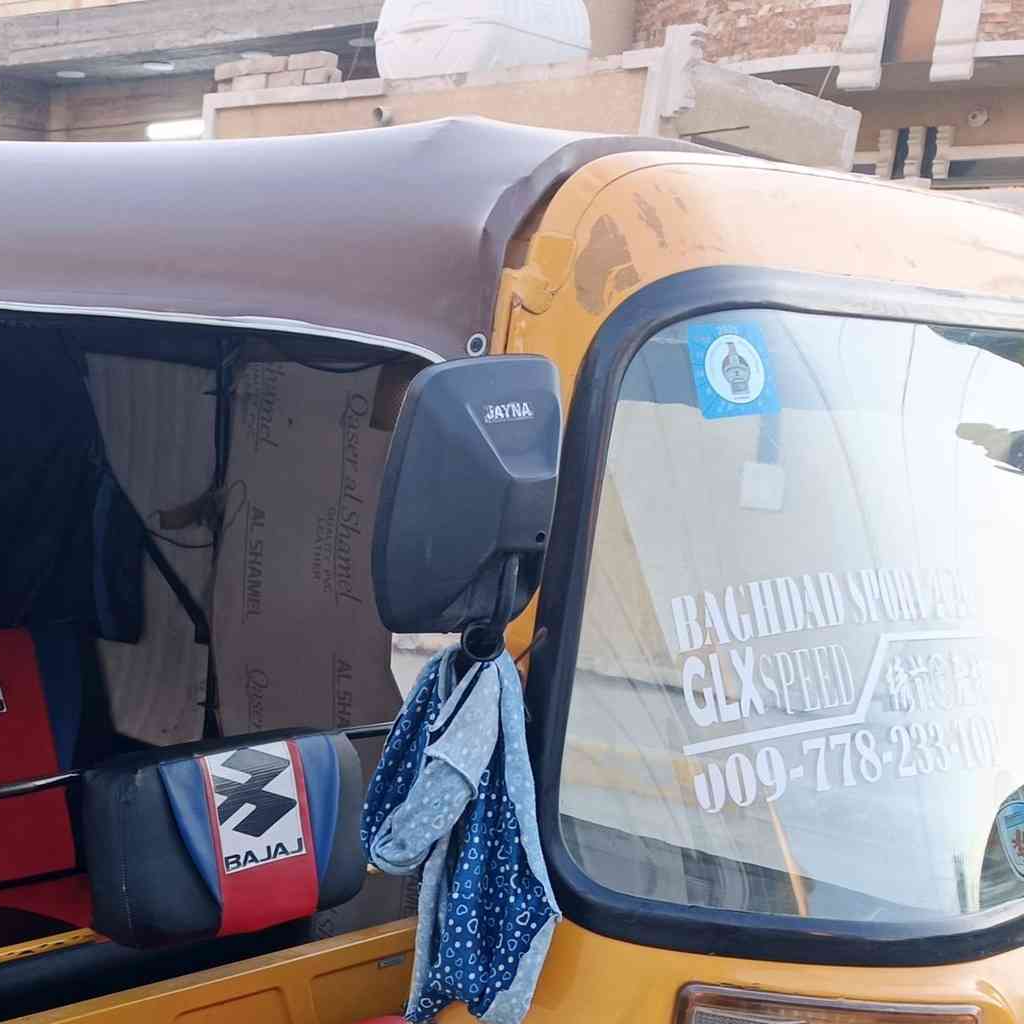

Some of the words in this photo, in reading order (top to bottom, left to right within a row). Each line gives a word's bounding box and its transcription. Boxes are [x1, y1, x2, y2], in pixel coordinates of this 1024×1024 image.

[485, 402, 532, 420] JAYNA
[343, 477, 365, 504] al
[249, 505, 264, 532] AL
[246, 538, 264, 616] SHAMEL
[336, 508, 363, 604] Shamel
[671, 572, 846, 654] BAGHDAD
[682, 647, 766, 728] GLX
[760, 643, 856, 715] SPEED
[225, 837, 304, 870] BAJAJ
